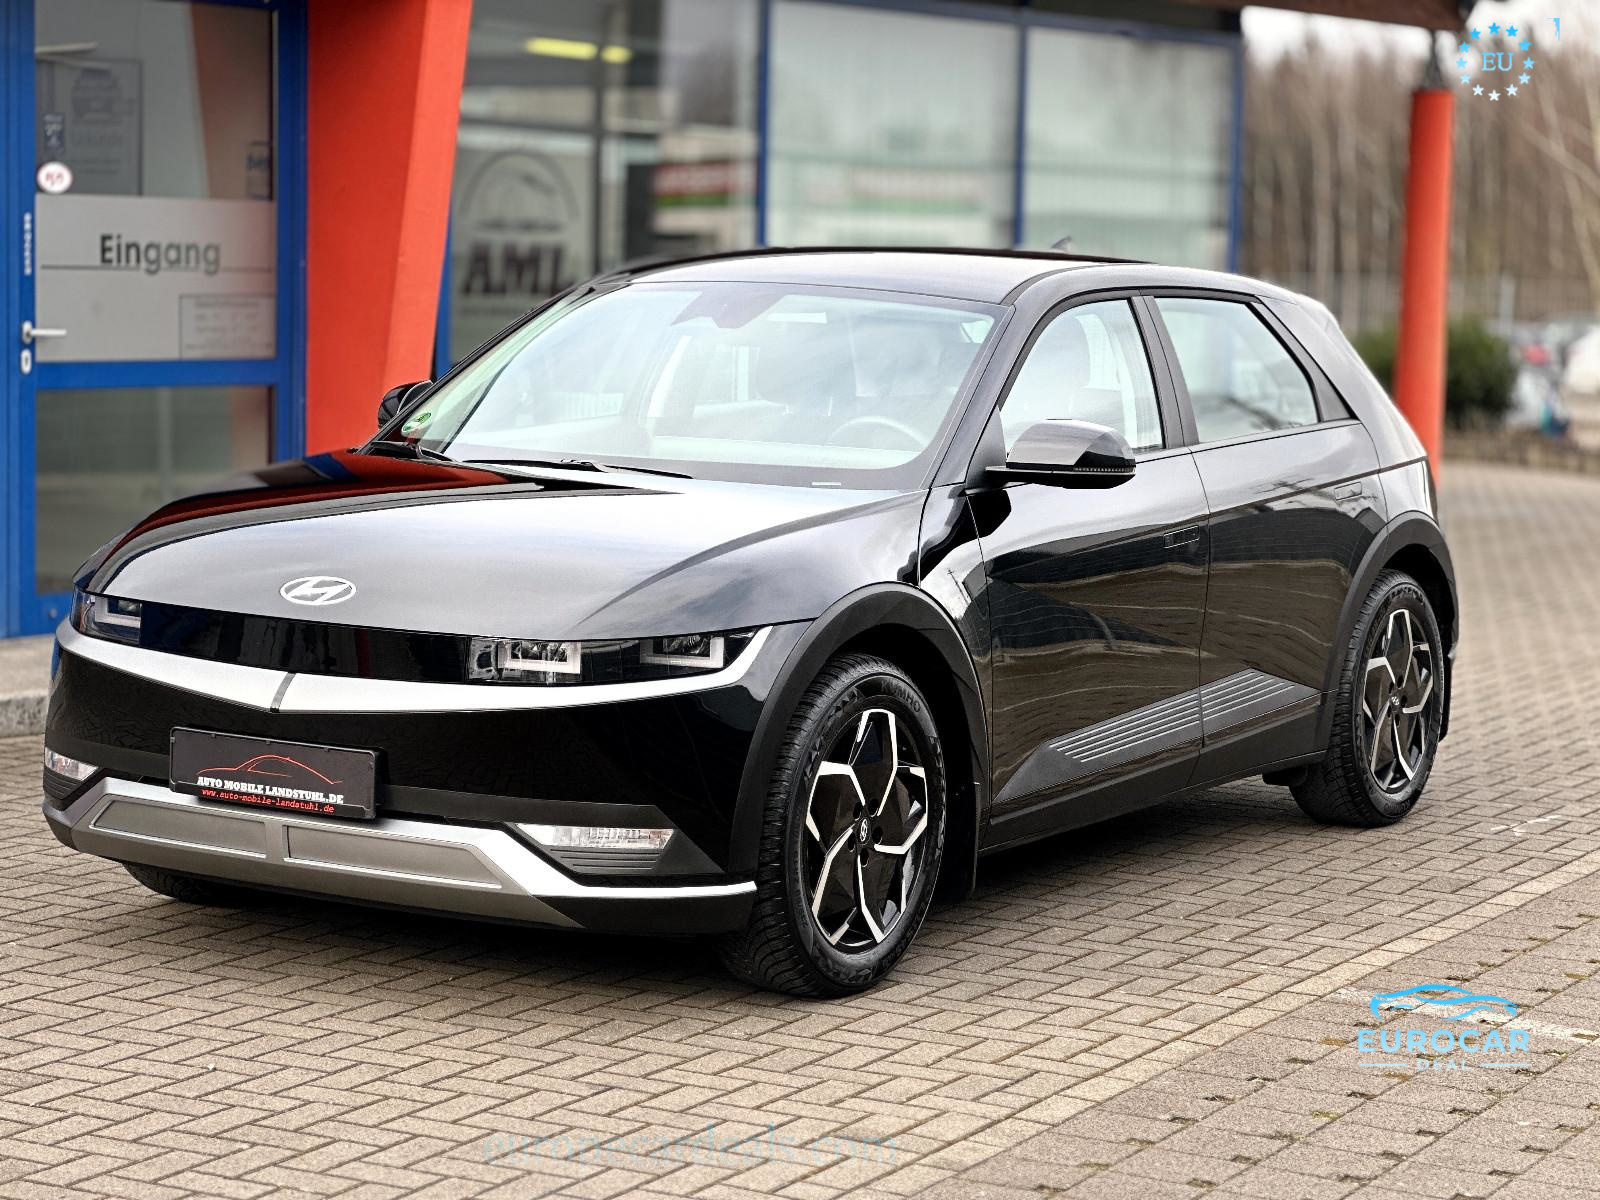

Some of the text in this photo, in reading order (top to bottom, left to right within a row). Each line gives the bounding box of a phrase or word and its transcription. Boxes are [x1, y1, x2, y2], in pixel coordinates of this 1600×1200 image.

[100, 234, 221, 275] Eingang
[463, 241, 575, 298] AML
[880, 678, 922, 713] KUMHO
[197, 776, 345, 805] AUTO MOBILE LANDSTUHL.DE
[202, 789, 335, 813] www.auto-mobile-landstuhl.de
